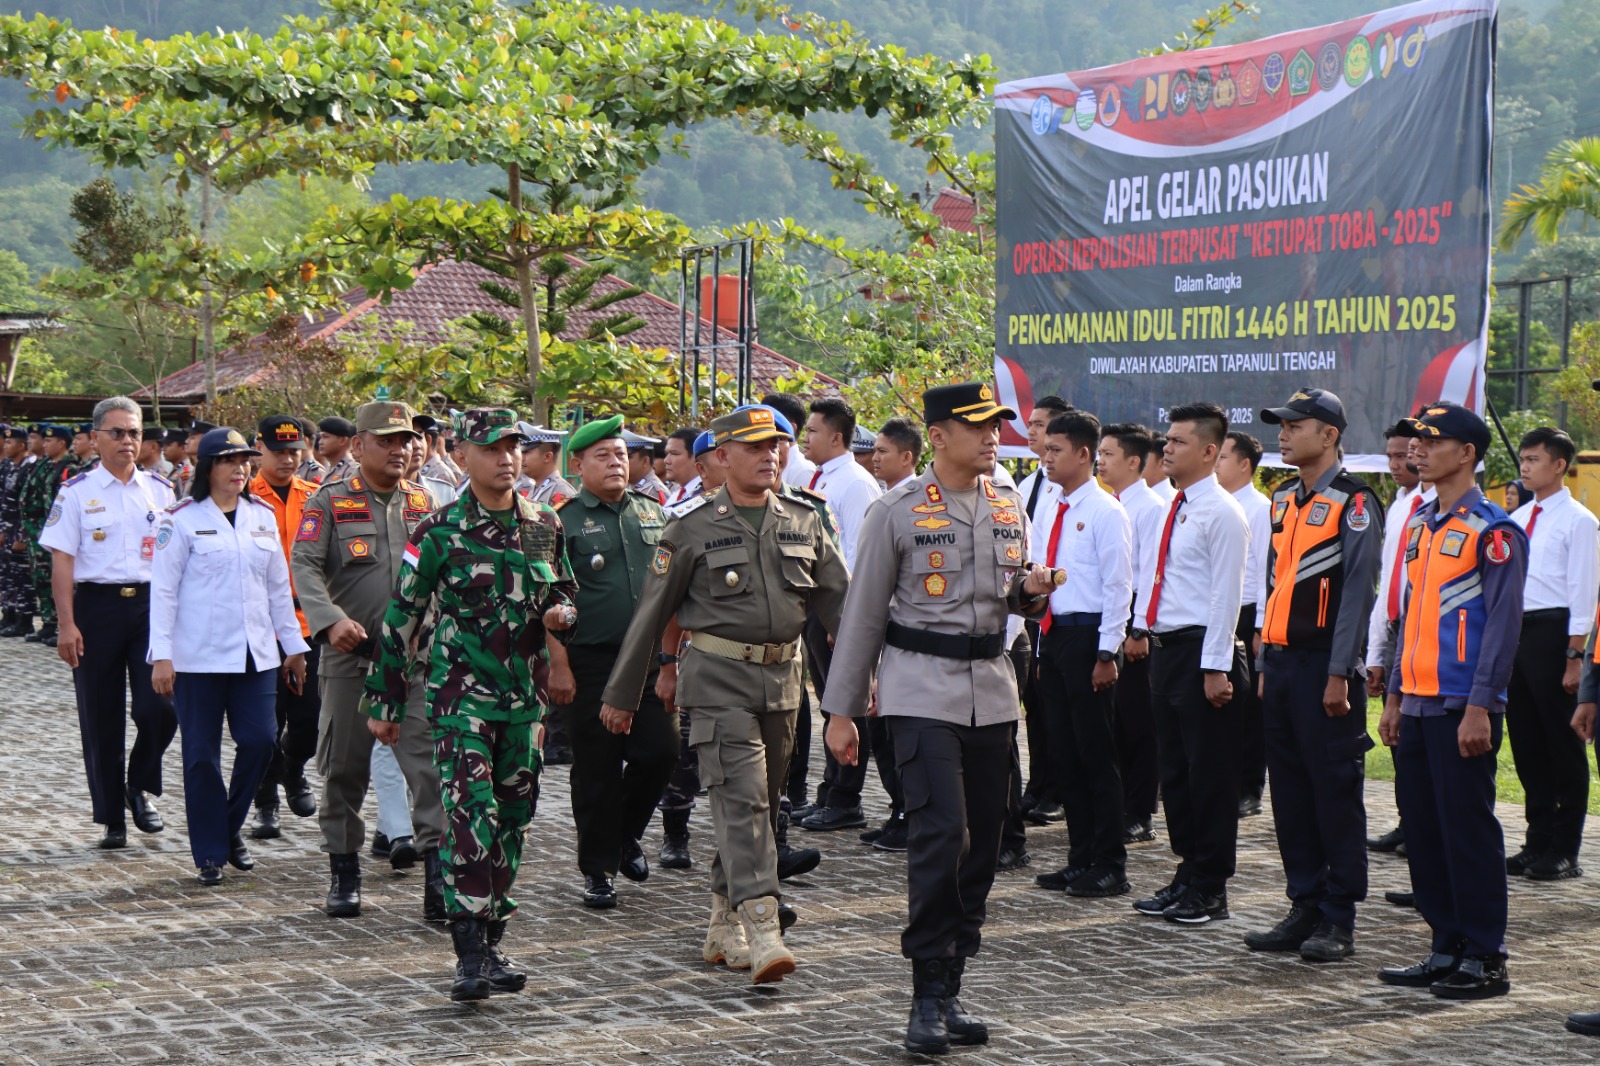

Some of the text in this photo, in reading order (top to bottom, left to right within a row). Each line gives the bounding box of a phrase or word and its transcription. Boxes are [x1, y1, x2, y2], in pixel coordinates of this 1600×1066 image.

[1103, 151, 1329, 224] APEL GELAR PASUKAN
[1013, 239, 1069, 275] OPERASI
[1072, 232, 1157, 272] KEPOLISIAN
[1161, 224, 1240, 265] TERPUSAT
[1243, 215, 1326, 258] "KETUPAT
[1329, 209, 1377, 251] TOBA
[1174, 272, 1242, 294] Dalam Rangka
[1008, 294, 1456, 345] PENGAMANAN IDUL FITRI 1446 H TAHUN 2025
[1090, 350, 1336, 375] DIWILAYAH KABUPATEN TAPANULI TENGAH
[1231, 407, 1253, 424] 2025
[704, 536, 743, 550] MAHMUD
[914, 532, 956, 546] WAHYU
